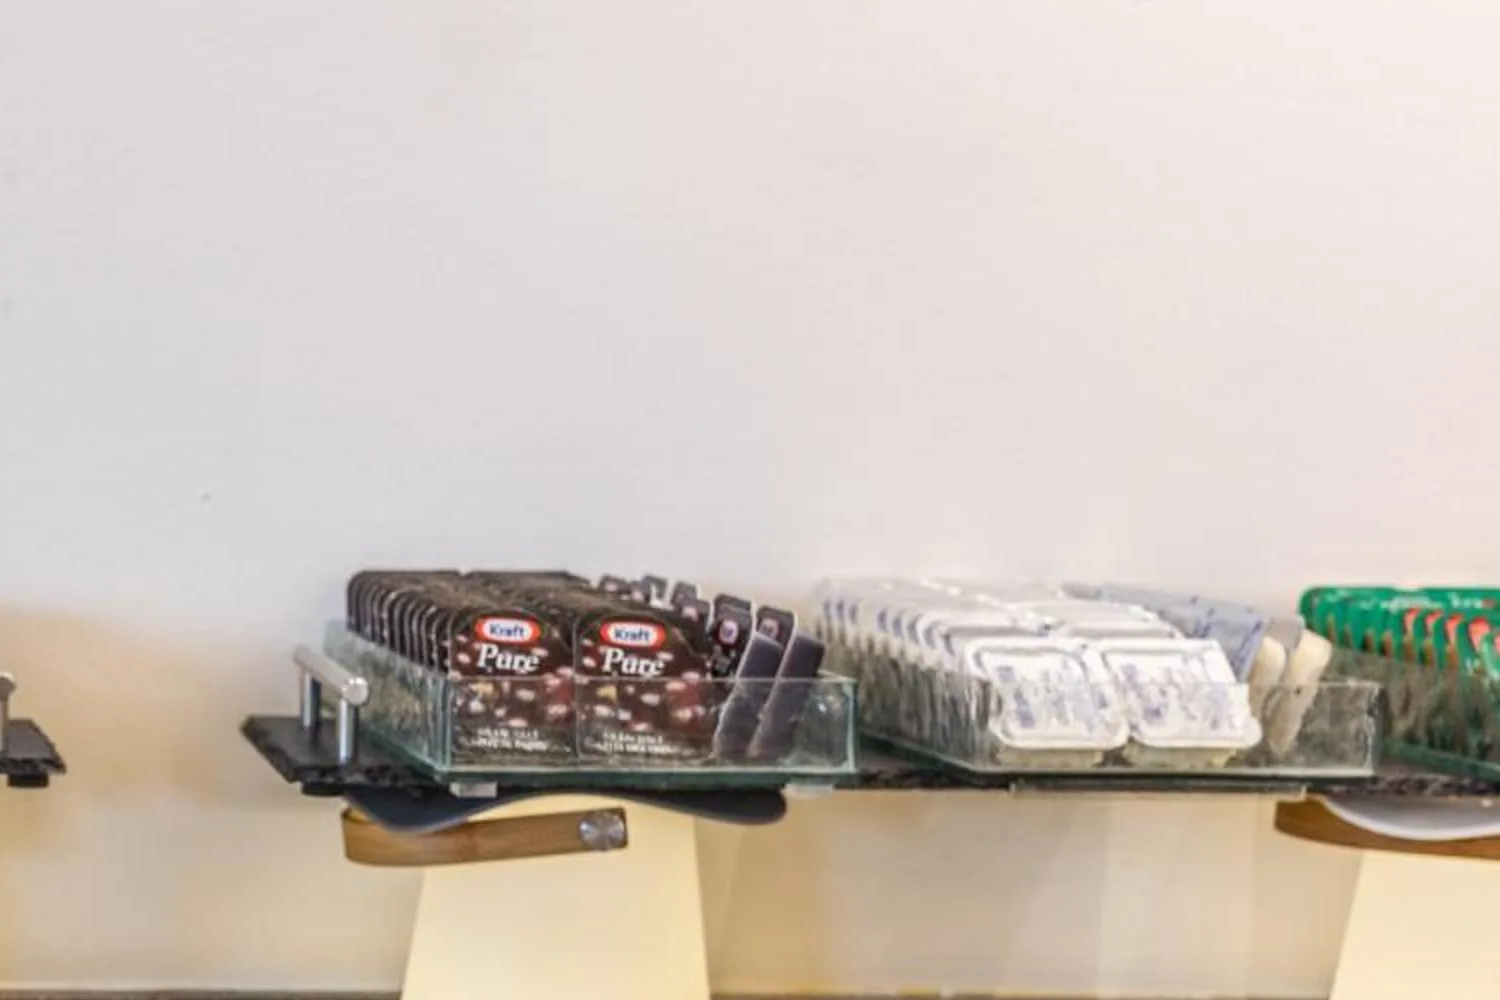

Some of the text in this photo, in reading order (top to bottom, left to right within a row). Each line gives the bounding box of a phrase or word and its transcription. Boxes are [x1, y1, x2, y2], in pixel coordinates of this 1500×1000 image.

[489, 622, 526, 637] Kraft
[613, 626, 651, 641] Kraft
[476, 643, 541, 674] Pure
[602, 647, 665, 677] Pure
